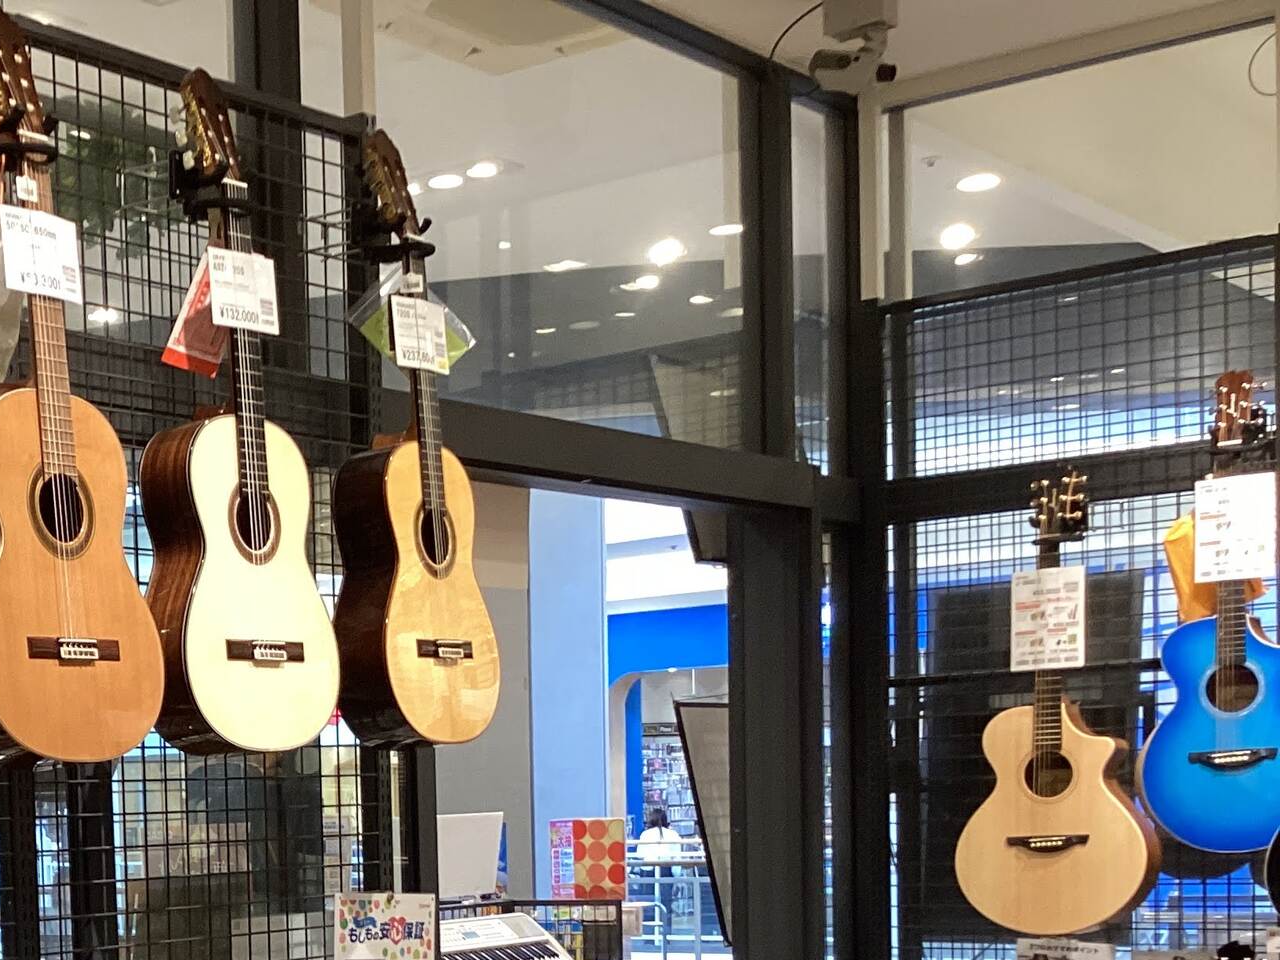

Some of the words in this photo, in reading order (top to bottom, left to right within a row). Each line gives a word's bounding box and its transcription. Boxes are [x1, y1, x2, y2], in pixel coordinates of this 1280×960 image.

[348, 919, 425, 944] もしもの安心保証
